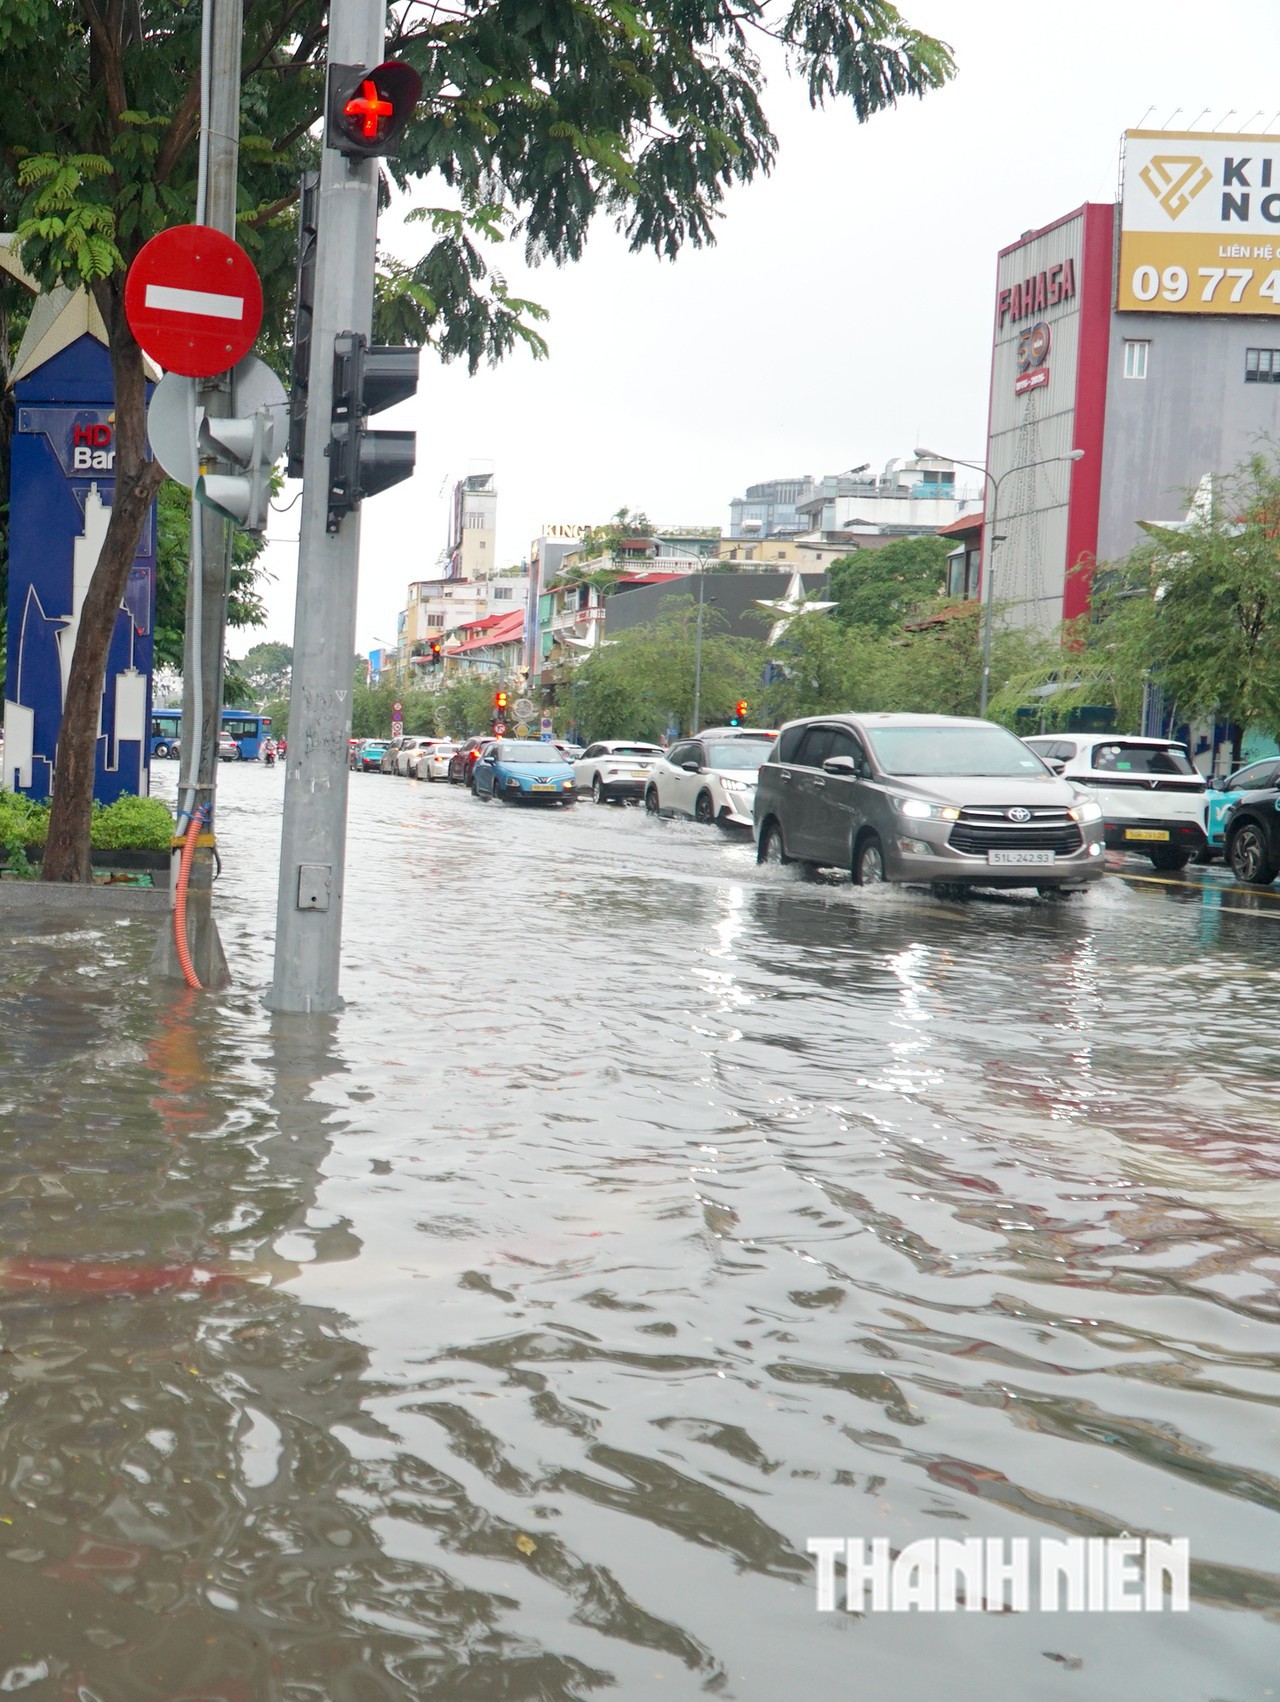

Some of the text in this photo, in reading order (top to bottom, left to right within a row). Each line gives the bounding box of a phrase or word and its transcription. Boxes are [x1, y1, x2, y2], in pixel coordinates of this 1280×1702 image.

[1218, 243, 1250, 258] LIÊN
[1253, 244, 1273, 260] HỆ
[998, 258, 1075, 331] FAHASA
[1017, 322, 1050, 372] 50
[74, 424, 111, 446] HD
[994, 853, 1049, 863] 51L-242.93
